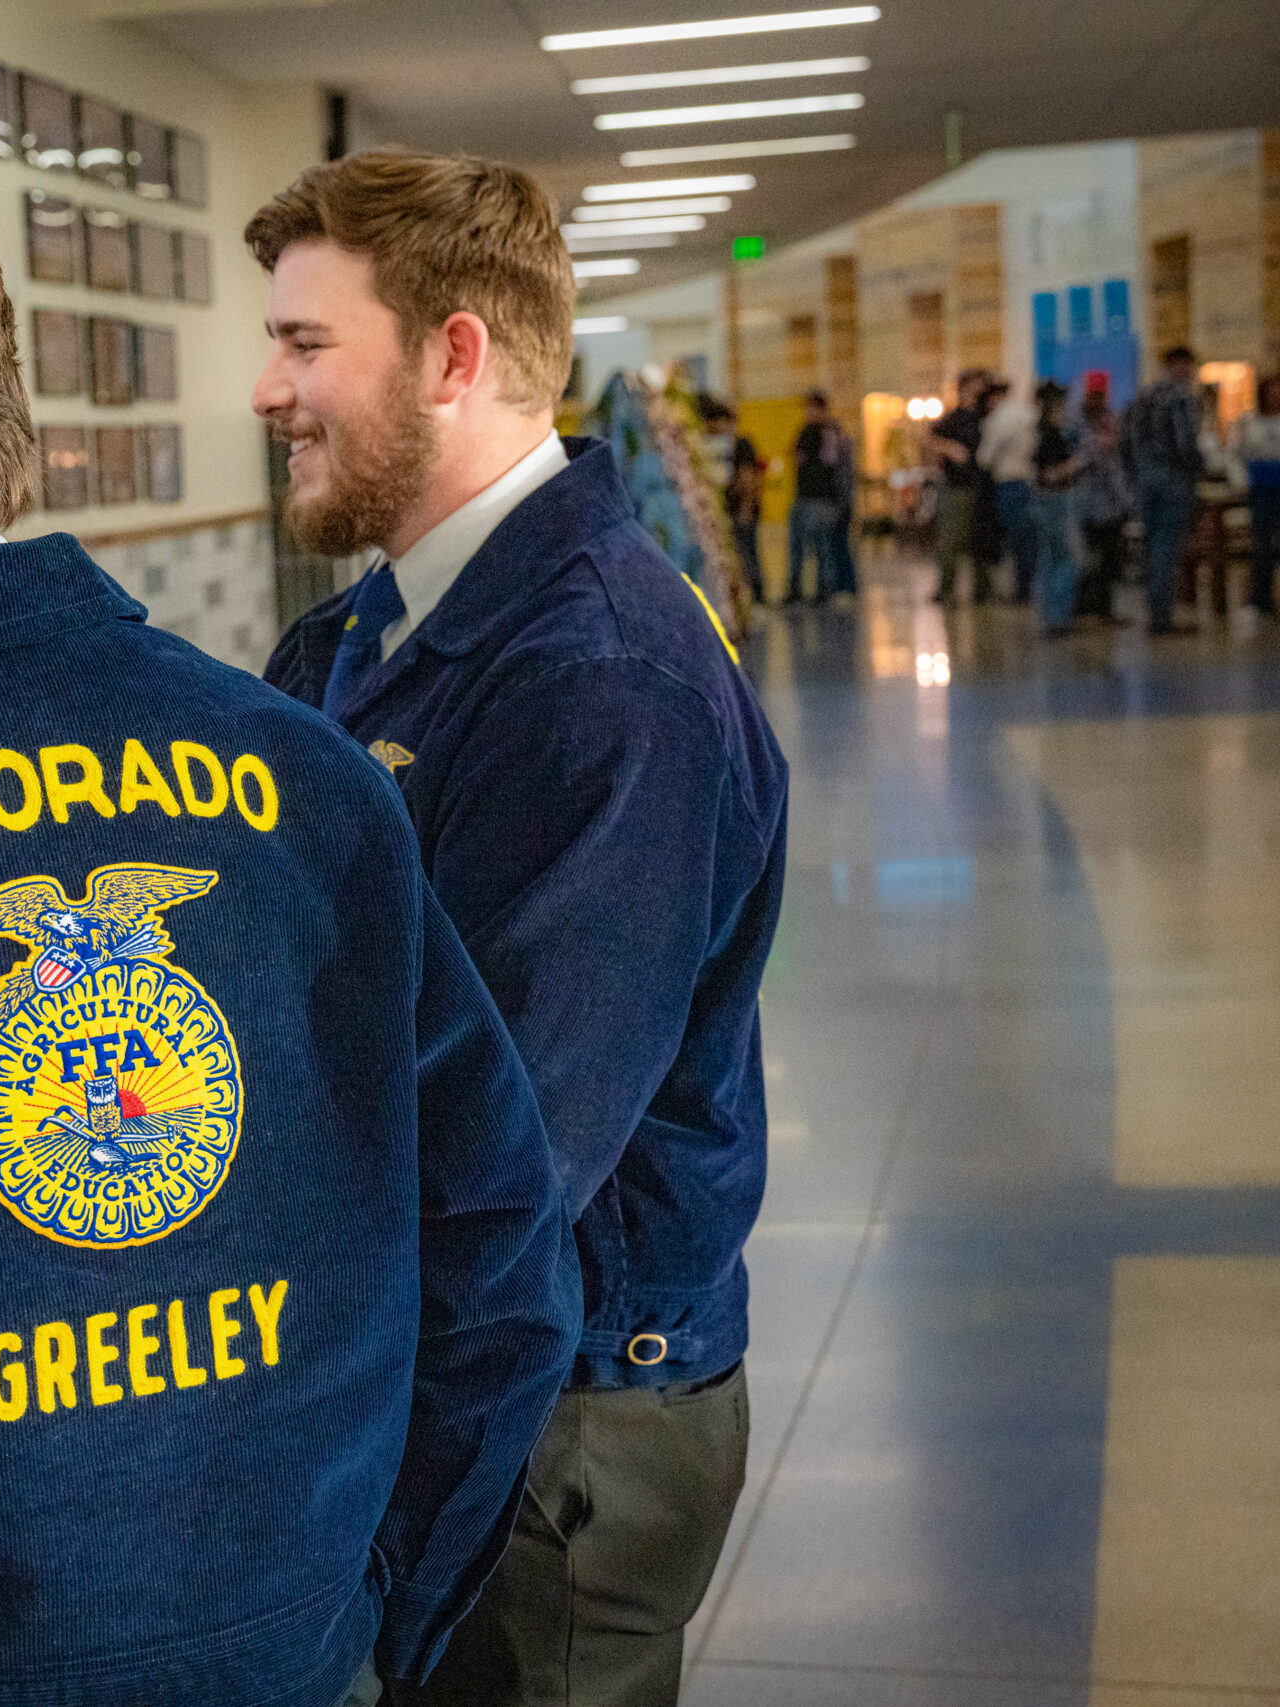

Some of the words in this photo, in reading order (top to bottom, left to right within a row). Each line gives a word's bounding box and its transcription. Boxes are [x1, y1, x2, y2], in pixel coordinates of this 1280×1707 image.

[16, 998, 196, 1096] AGRICULTURAL
[55, 1029, 161, 1083] FFA
[43, 1132, 196, 1201] EDUCATION
